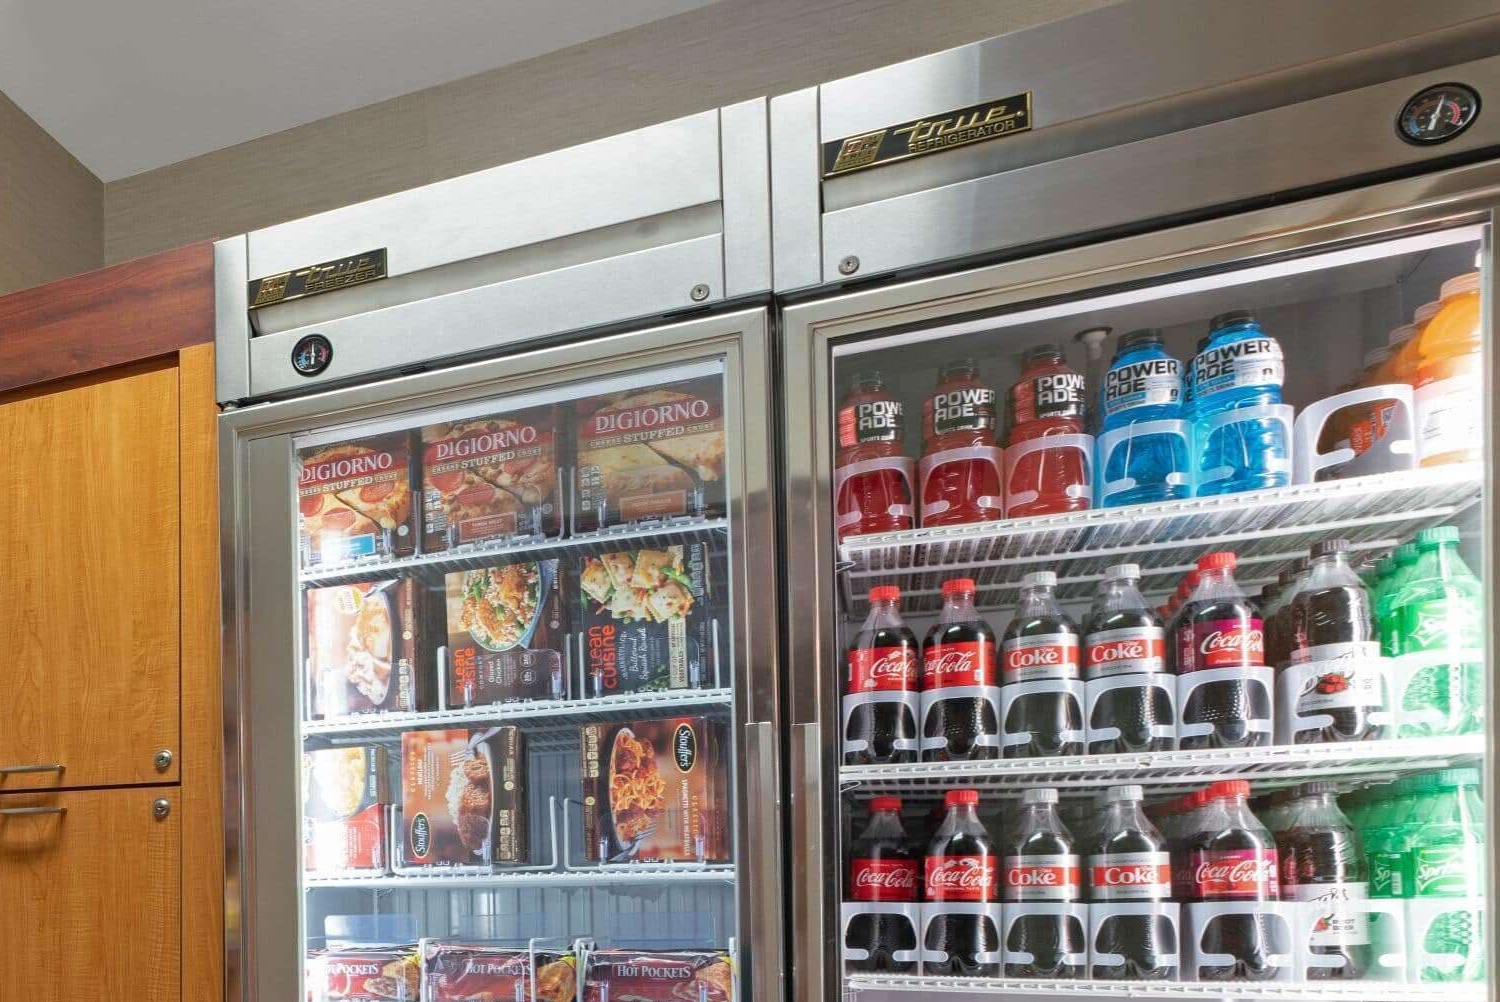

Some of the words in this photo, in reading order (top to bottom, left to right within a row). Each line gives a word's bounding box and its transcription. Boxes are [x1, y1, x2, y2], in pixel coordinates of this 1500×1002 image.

[908, 119, 1016, 154] REFRIGERATOR
[304, 269, 377, 293] FREEZER
[1195, 339, 1271, 366] POWER
[1107, 359, 1178, 387] POWER
[1195, 358, 1236, 383] ADE
[1037, 374, 1085, 392] POWE
[1106, 377, 1148, 400] ADE
[933, 388, 996, 410] POWER
[1037, 386, 1079, 405] ADE
[859, 414, 895, 431] ADE
[933, 403, 975, 422] ADE
[623, 426, 686, 445] STUFFED
[461, 451, 516, 469] STUFFED
[322, 476, 373, 493] STUFFED
[601, 624, 617, 689] cuisine
[1009, 648, 1060, 669] Coke
[1091, 641, 1143, 664] Coke
[856, 867, 914, 889] Coca-Cola
[1008, 868, 1057, 886] Coke
[1104, 866, 1158, 886] Coke
[617, 965, 639, 977] HOT
[641, 965, 692, 979] POCKETS
